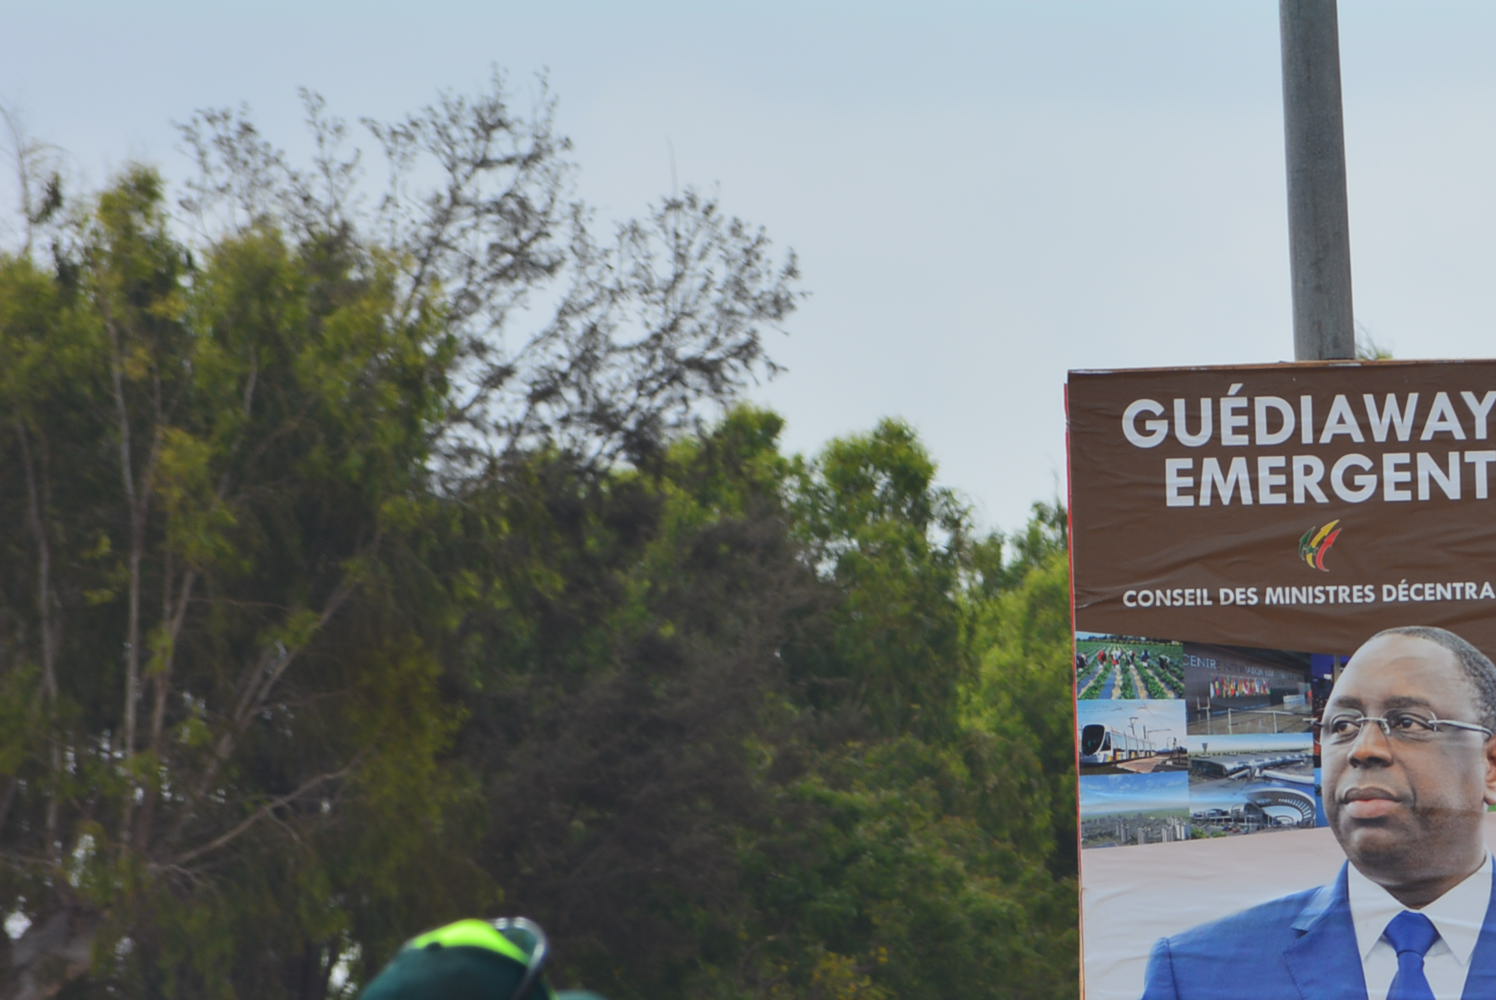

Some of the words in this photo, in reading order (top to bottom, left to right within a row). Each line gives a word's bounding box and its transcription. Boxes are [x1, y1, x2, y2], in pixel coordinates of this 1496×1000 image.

[1122, 588, 1213, 608] CONSEIL
[1219, 586, 1259, 606] DES
[1264, 584, 1376, 605] MINISTRES
